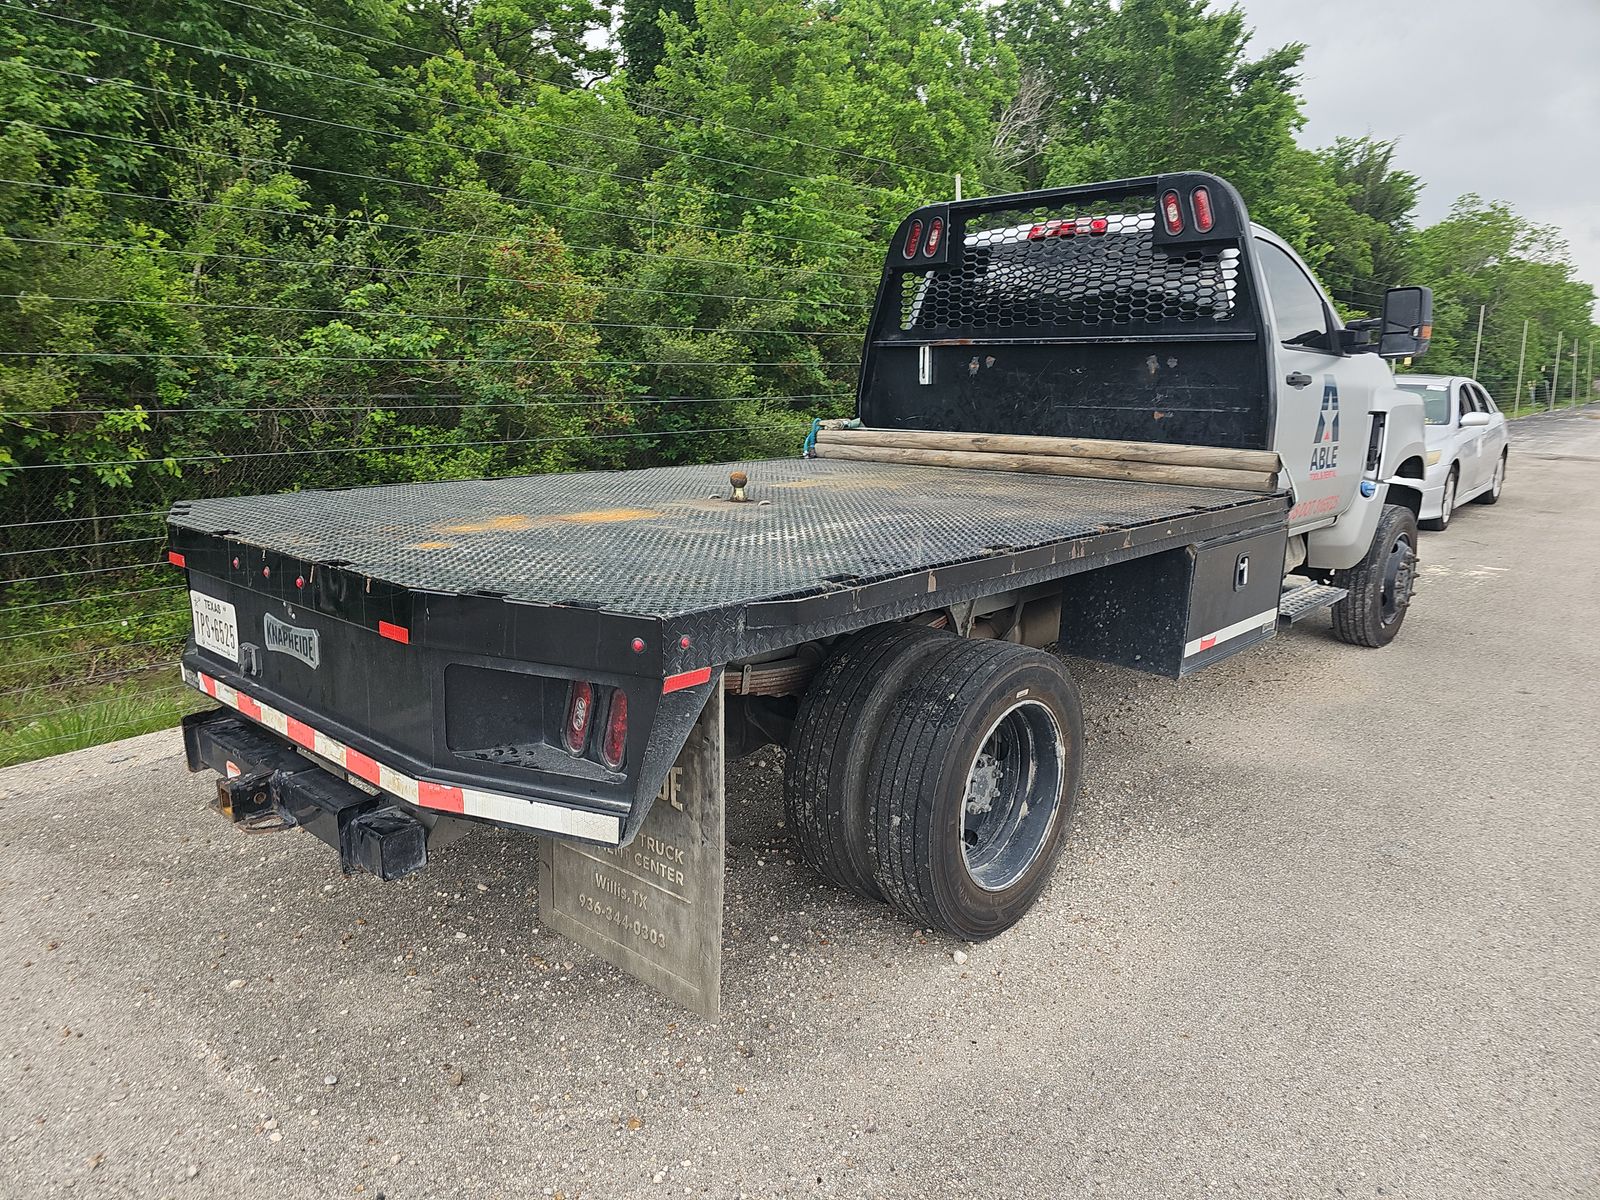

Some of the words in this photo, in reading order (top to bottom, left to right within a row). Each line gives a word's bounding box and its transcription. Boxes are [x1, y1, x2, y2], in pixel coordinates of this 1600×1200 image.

[1310, 446, 1339, 471] ABLE
[203, 599, 222, 615] TEXAS
[266, 619, 314, 662] KNAPHEIDE
[638, 833, 685, 865] TRUCK
[634, 853, 685, 887] CENTER
[632, 888, 649, 911] TX
